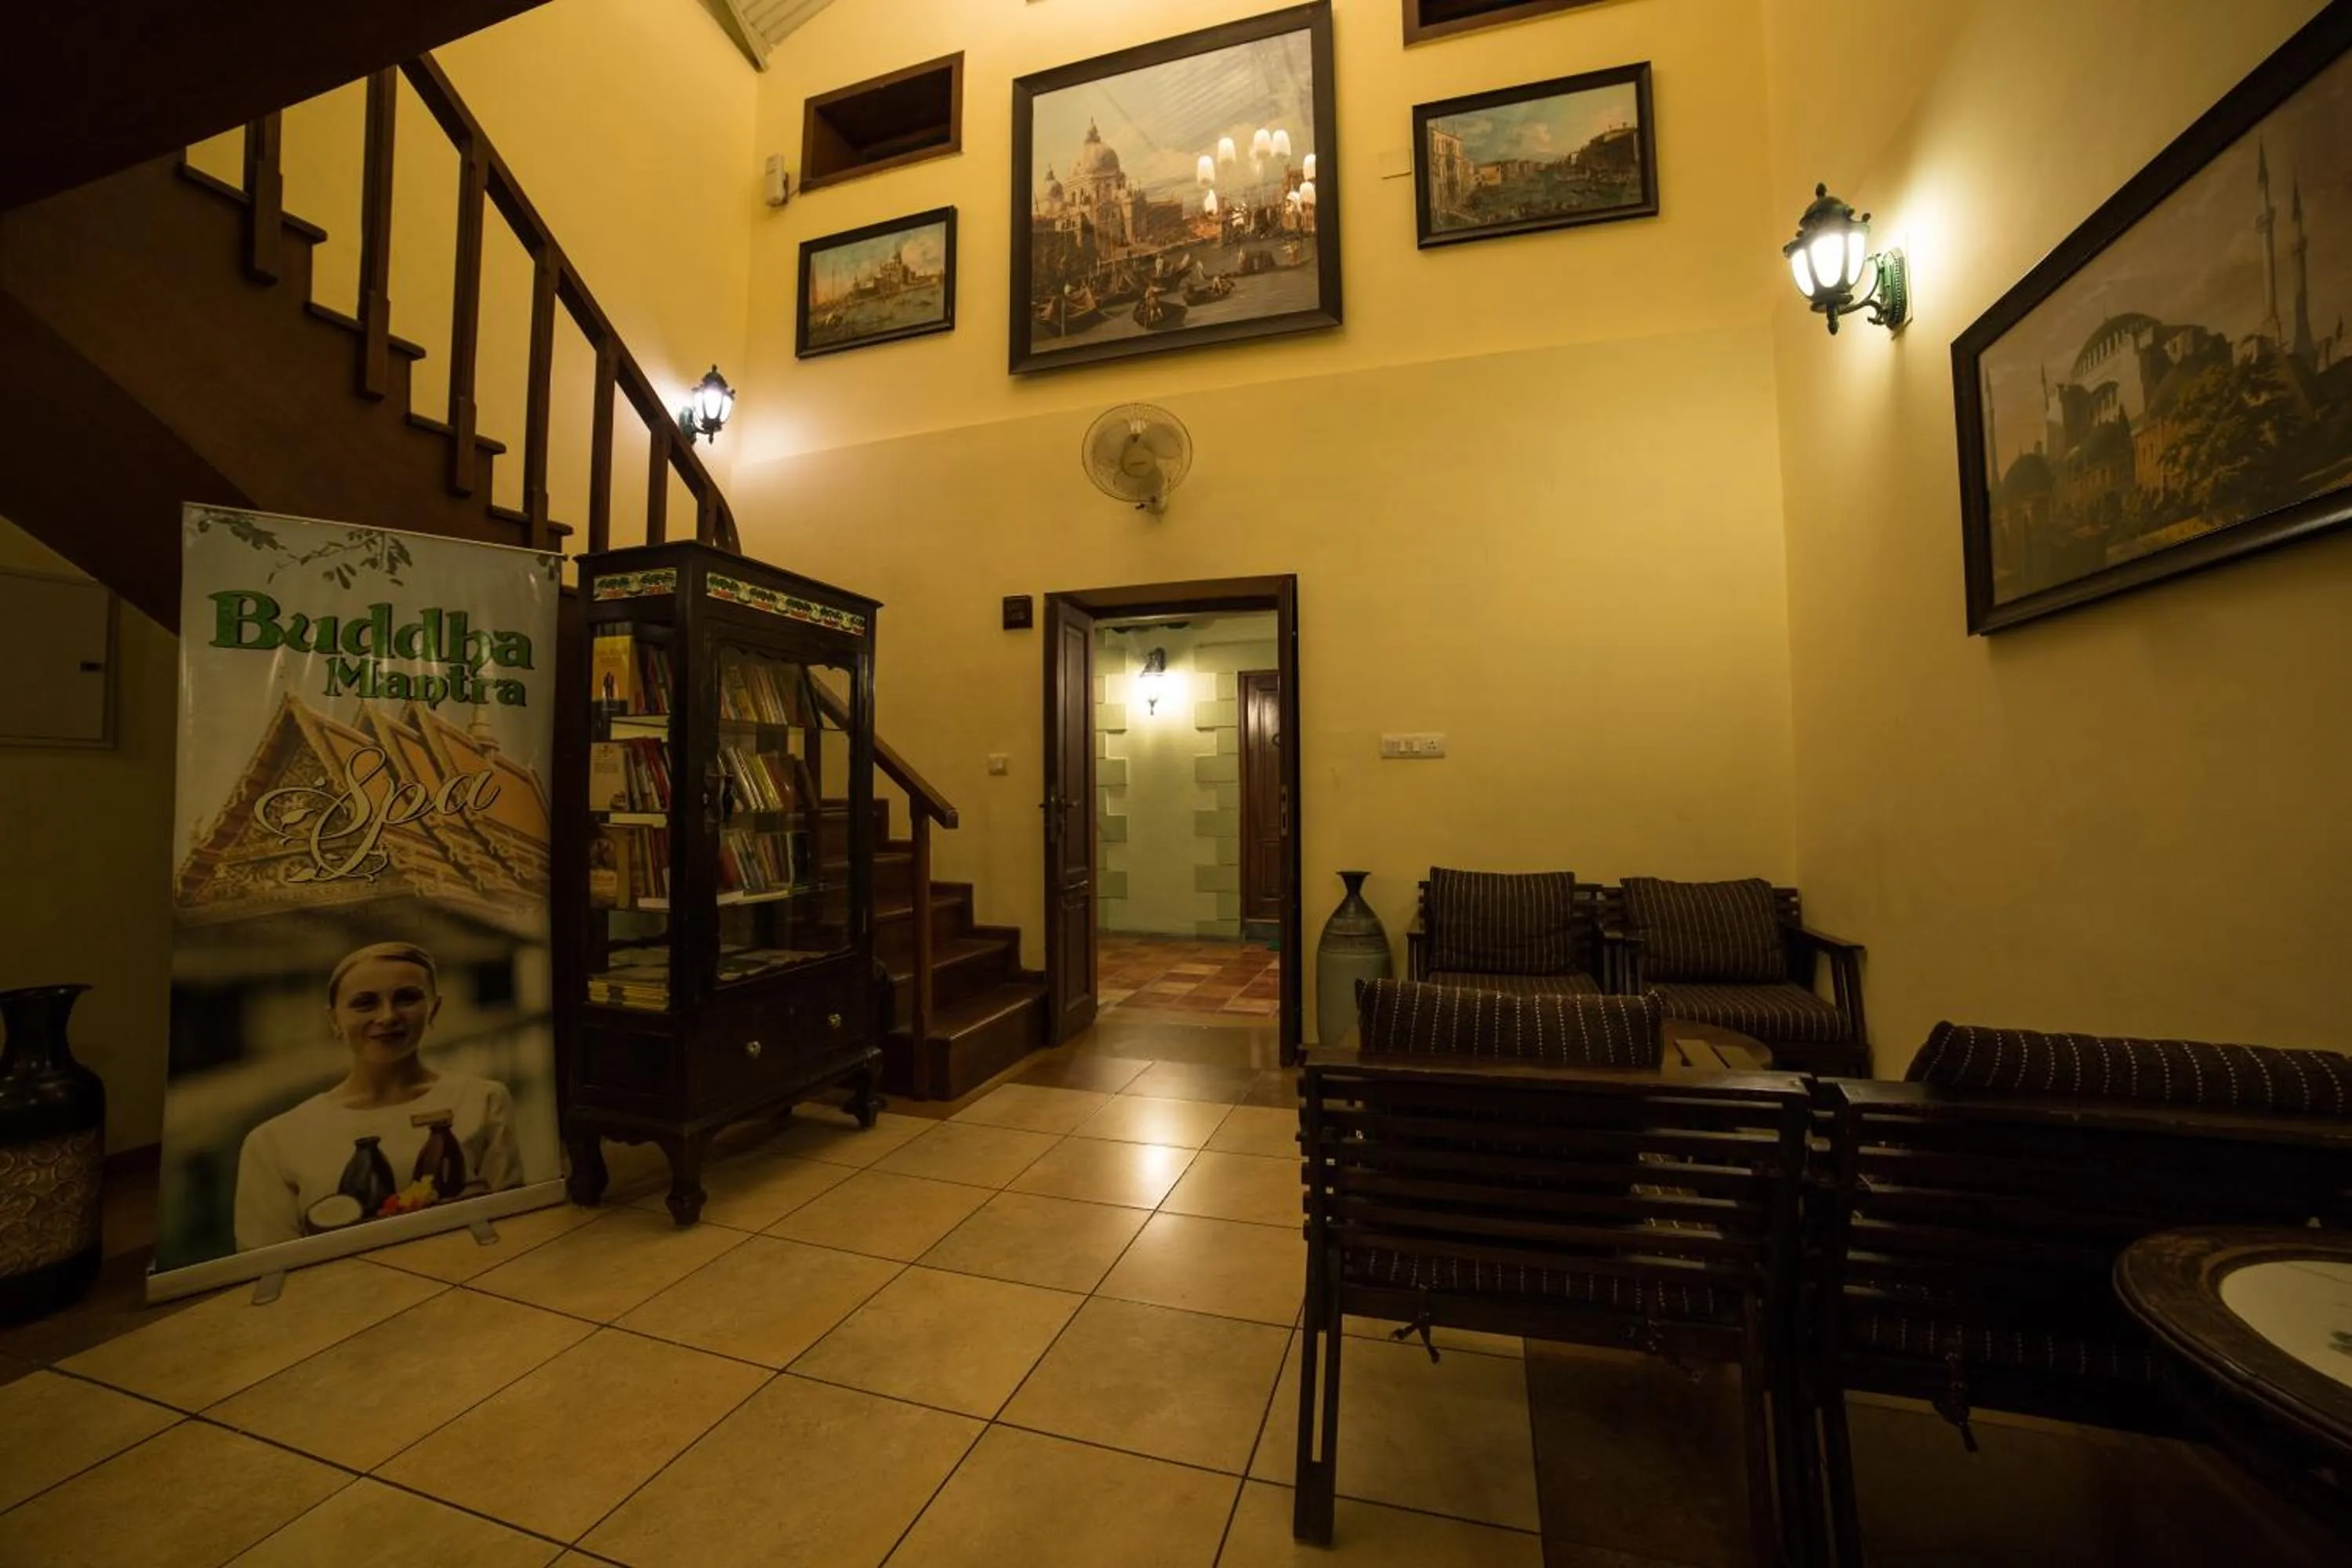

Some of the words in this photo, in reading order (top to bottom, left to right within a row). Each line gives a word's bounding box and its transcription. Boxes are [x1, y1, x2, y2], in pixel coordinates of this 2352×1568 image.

[207, 589, 535, 672] Buddha
[322, 656, 527, 709] Mantra
[252, 745, 502, 884] Spa
